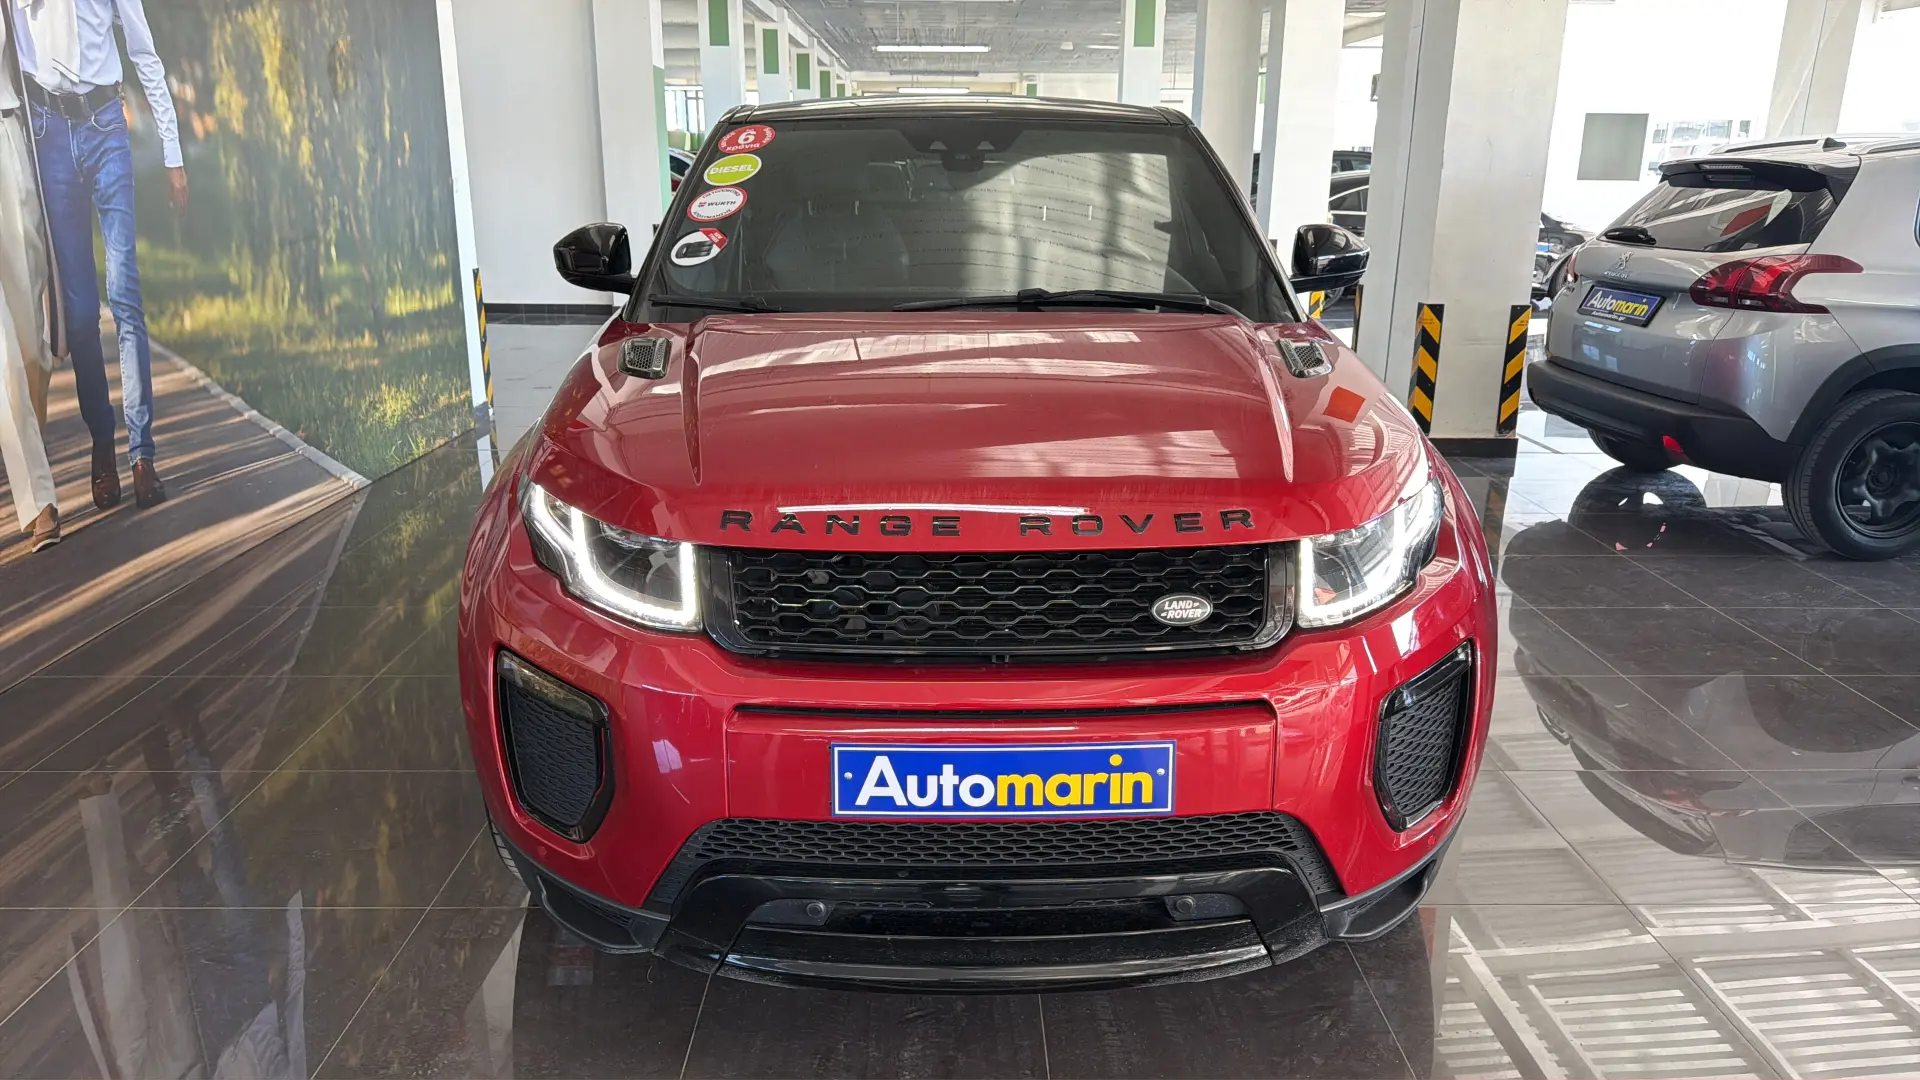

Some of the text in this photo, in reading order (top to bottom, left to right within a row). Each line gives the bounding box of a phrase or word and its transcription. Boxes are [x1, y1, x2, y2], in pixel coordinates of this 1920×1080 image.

[737, 130, 757, 144] 6
[709, 164, 754, 174] DIESEL
[1586, 290, 1649, 316] Automarin
[720, 509, 1254, 536] RANGE ROVER
[1164, 600, 1193, 610] LAND
[1167, 608, 1202, 619] ROVER
[854, 754, 1153, 807] Automarin
